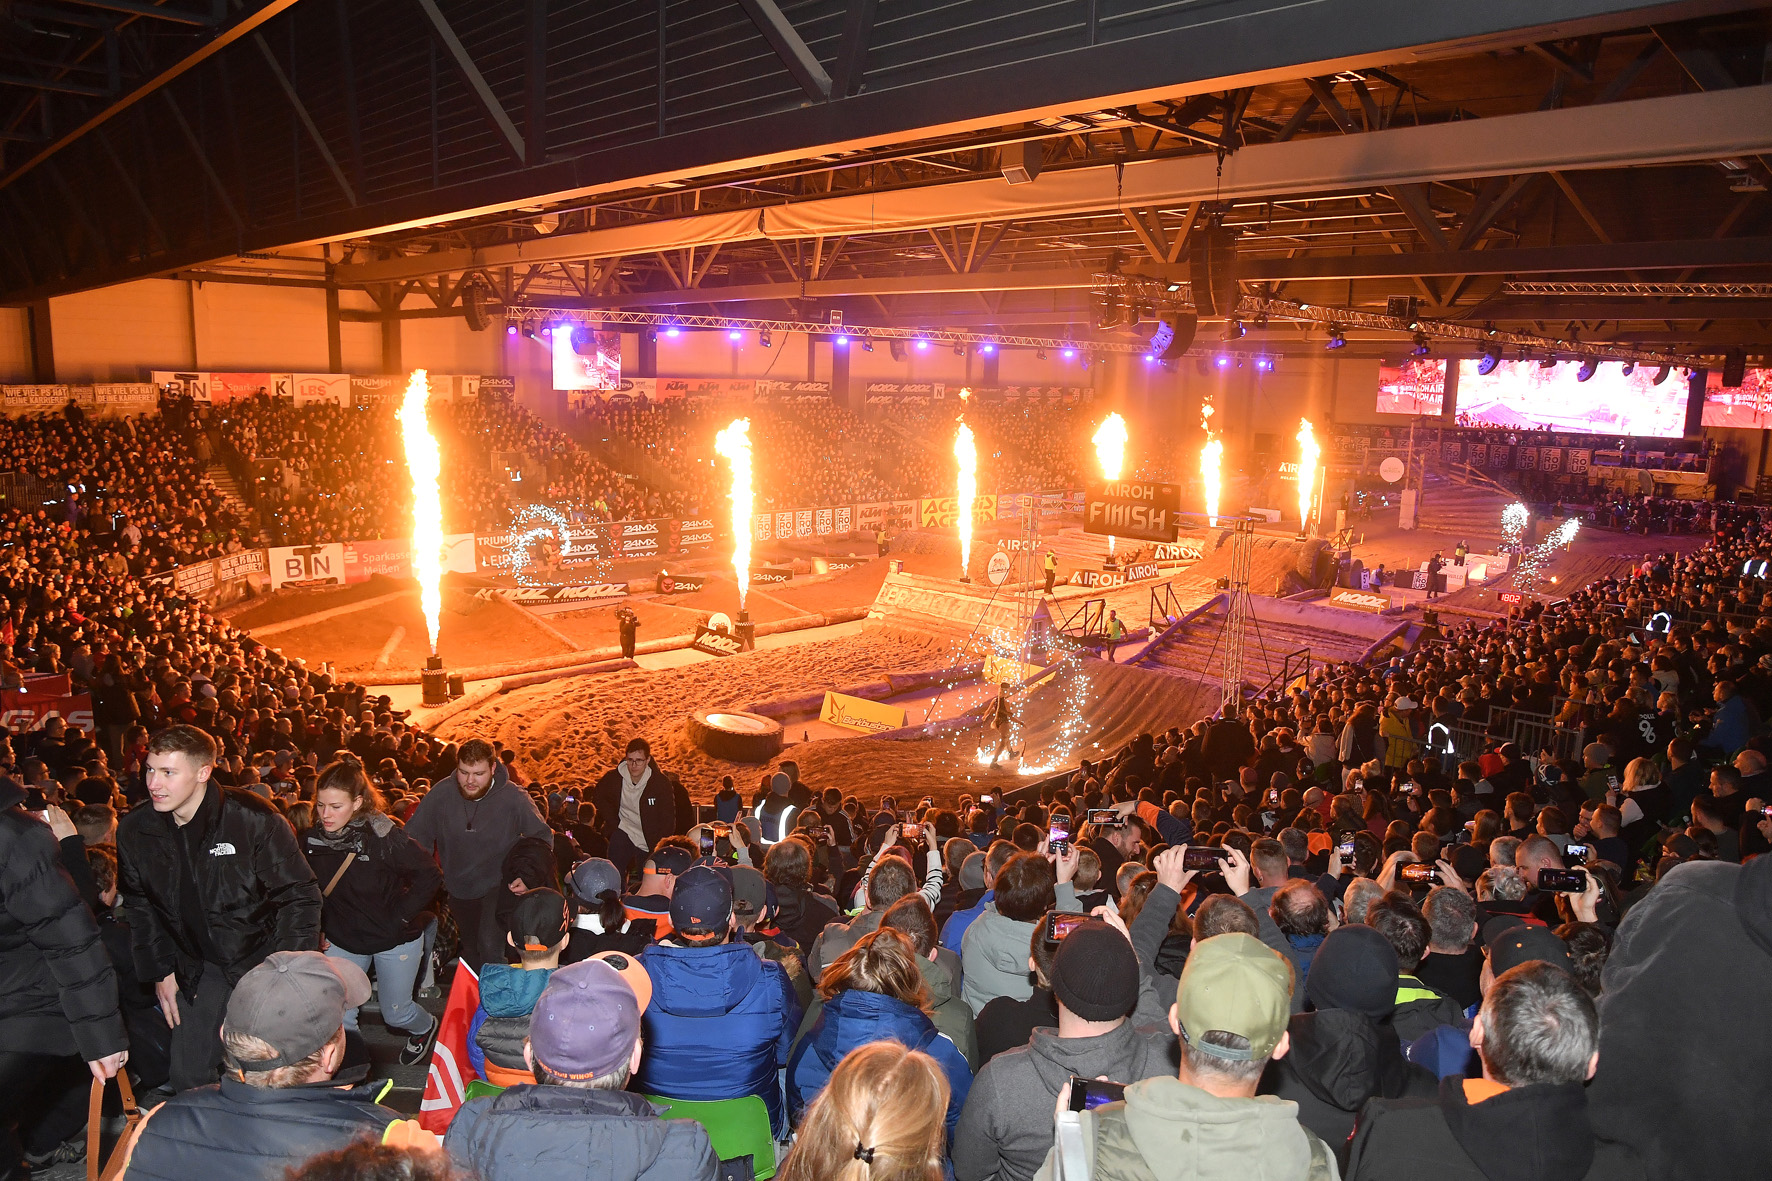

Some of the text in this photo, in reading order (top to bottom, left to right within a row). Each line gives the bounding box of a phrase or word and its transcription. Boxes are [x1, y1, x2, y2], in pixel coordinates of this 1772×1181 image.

[97, 385, 154, 395] WIE VIEL PS HAT
[275, 380, 287, 394] K
[300, 385, 327, 397] LBS
[468, 382, 476, 395] L
[665, 381, 689, 390] KTM
[1103, 482, 1154, 500] AIROH
[860, 506, 882, 518] KTM
[1089, 501, 1166, 531] FINISH
[623, 523, 657, 533] 24MX
[682, 519, 713, 528] 24MX
[623, 538, 657, 547] 24MX
[682, 532, 712, 541] 24MX
[362, 551, 412, 564] Sparkasse
[1154, 544, 1204, 560] AIROH
[285, 545, 331, 580] BTN
[363, 563, 400, 575] Meißen
[753, 573, 788, 582] 24MX
[1128, 563, 1159, 580] AIROH
[1070, 571, 1125, 587] AIROH
[554, 583, 628, 599] MOTOZ
[1333, 591, 1388, 609] MOTOZ
[696, 631, 742, 655] MOTOZ
